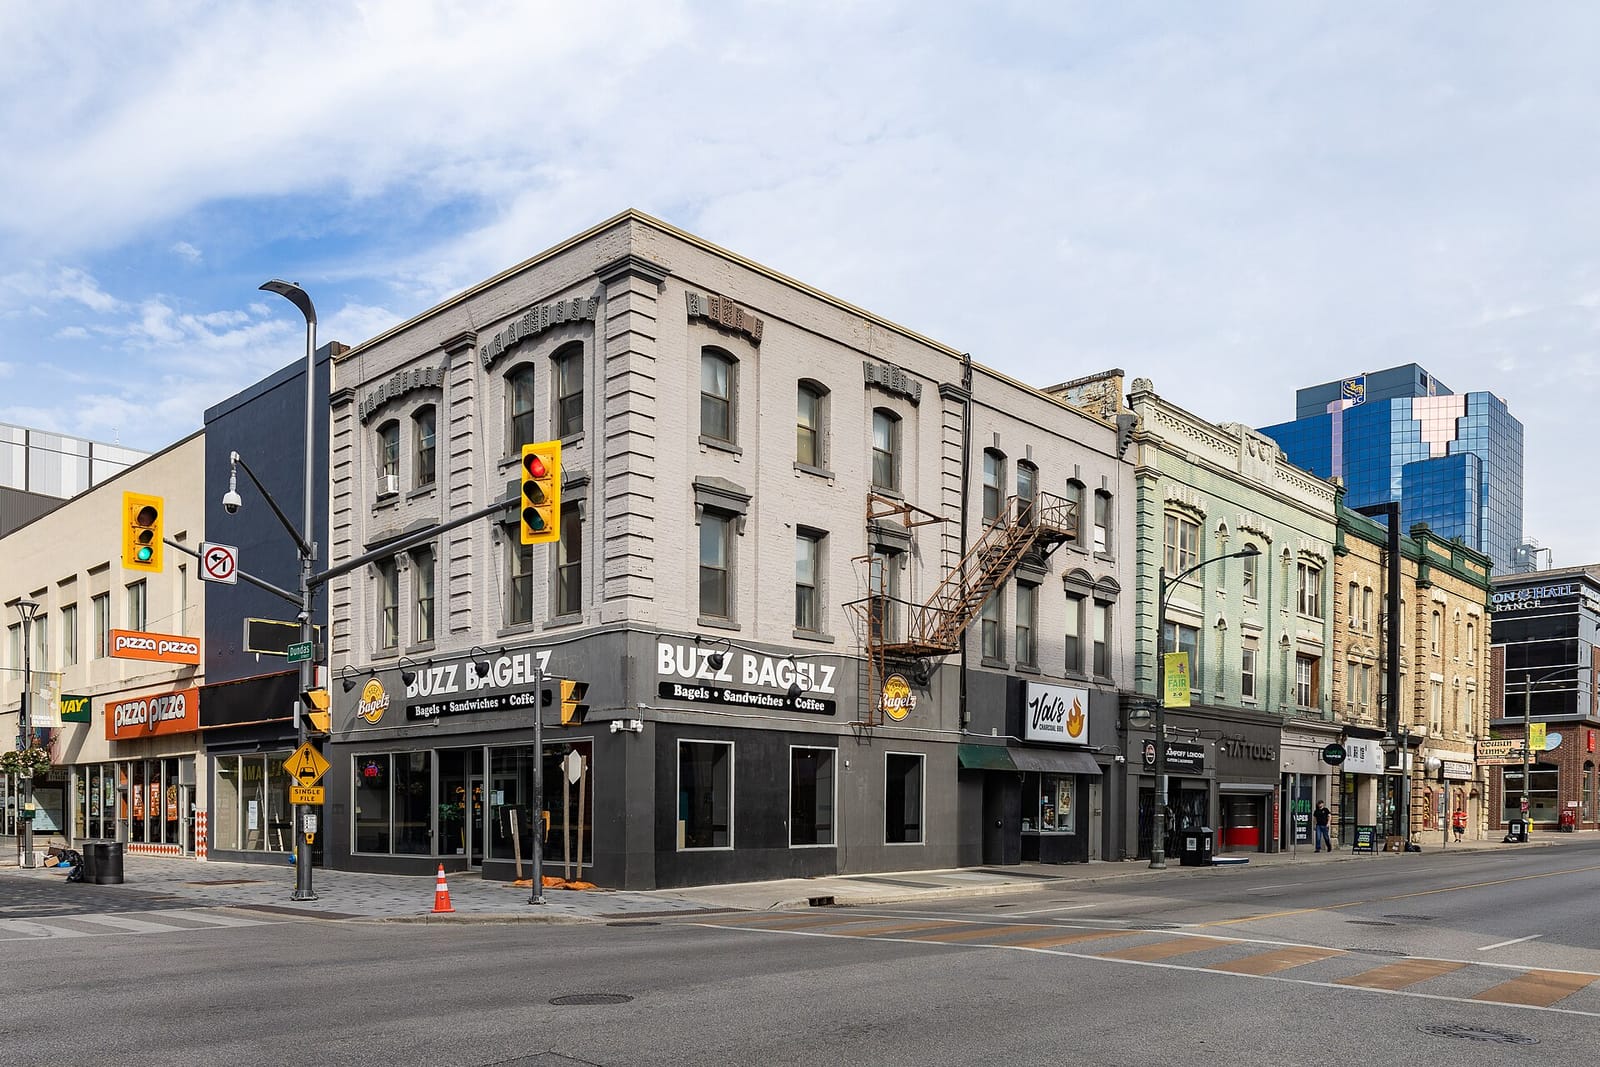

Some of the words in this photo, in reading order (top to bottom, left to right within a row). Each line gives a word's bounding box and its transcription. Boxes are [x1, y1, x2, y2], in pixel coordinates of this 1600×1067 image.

[406, 664, 459, 698] BUZZ
[465, 650, 553, 691] BAGELZ
[657, 643, 734, 682] BUZZ
[742, 654, 836, 694] BAGELZ
[1168, 679, 1186, 687] FAIR
[357, 693, 389, 718] Bagelz
[415, 705, 440, 717] Bagels
[449, 698, 498, 712] Sandwiches
[509, 694, 535, 706] Coffe
[673, 684, 710, 700] Bagels
[723, 690, 783, 708] Sandwiches
[795, 697, 825, 711] Coffee
[877, 691, 917, 711] Bagelz
[1029, 692, 1065, 729] Val's
[1227, 741, 1274, 760] TATTOOS
